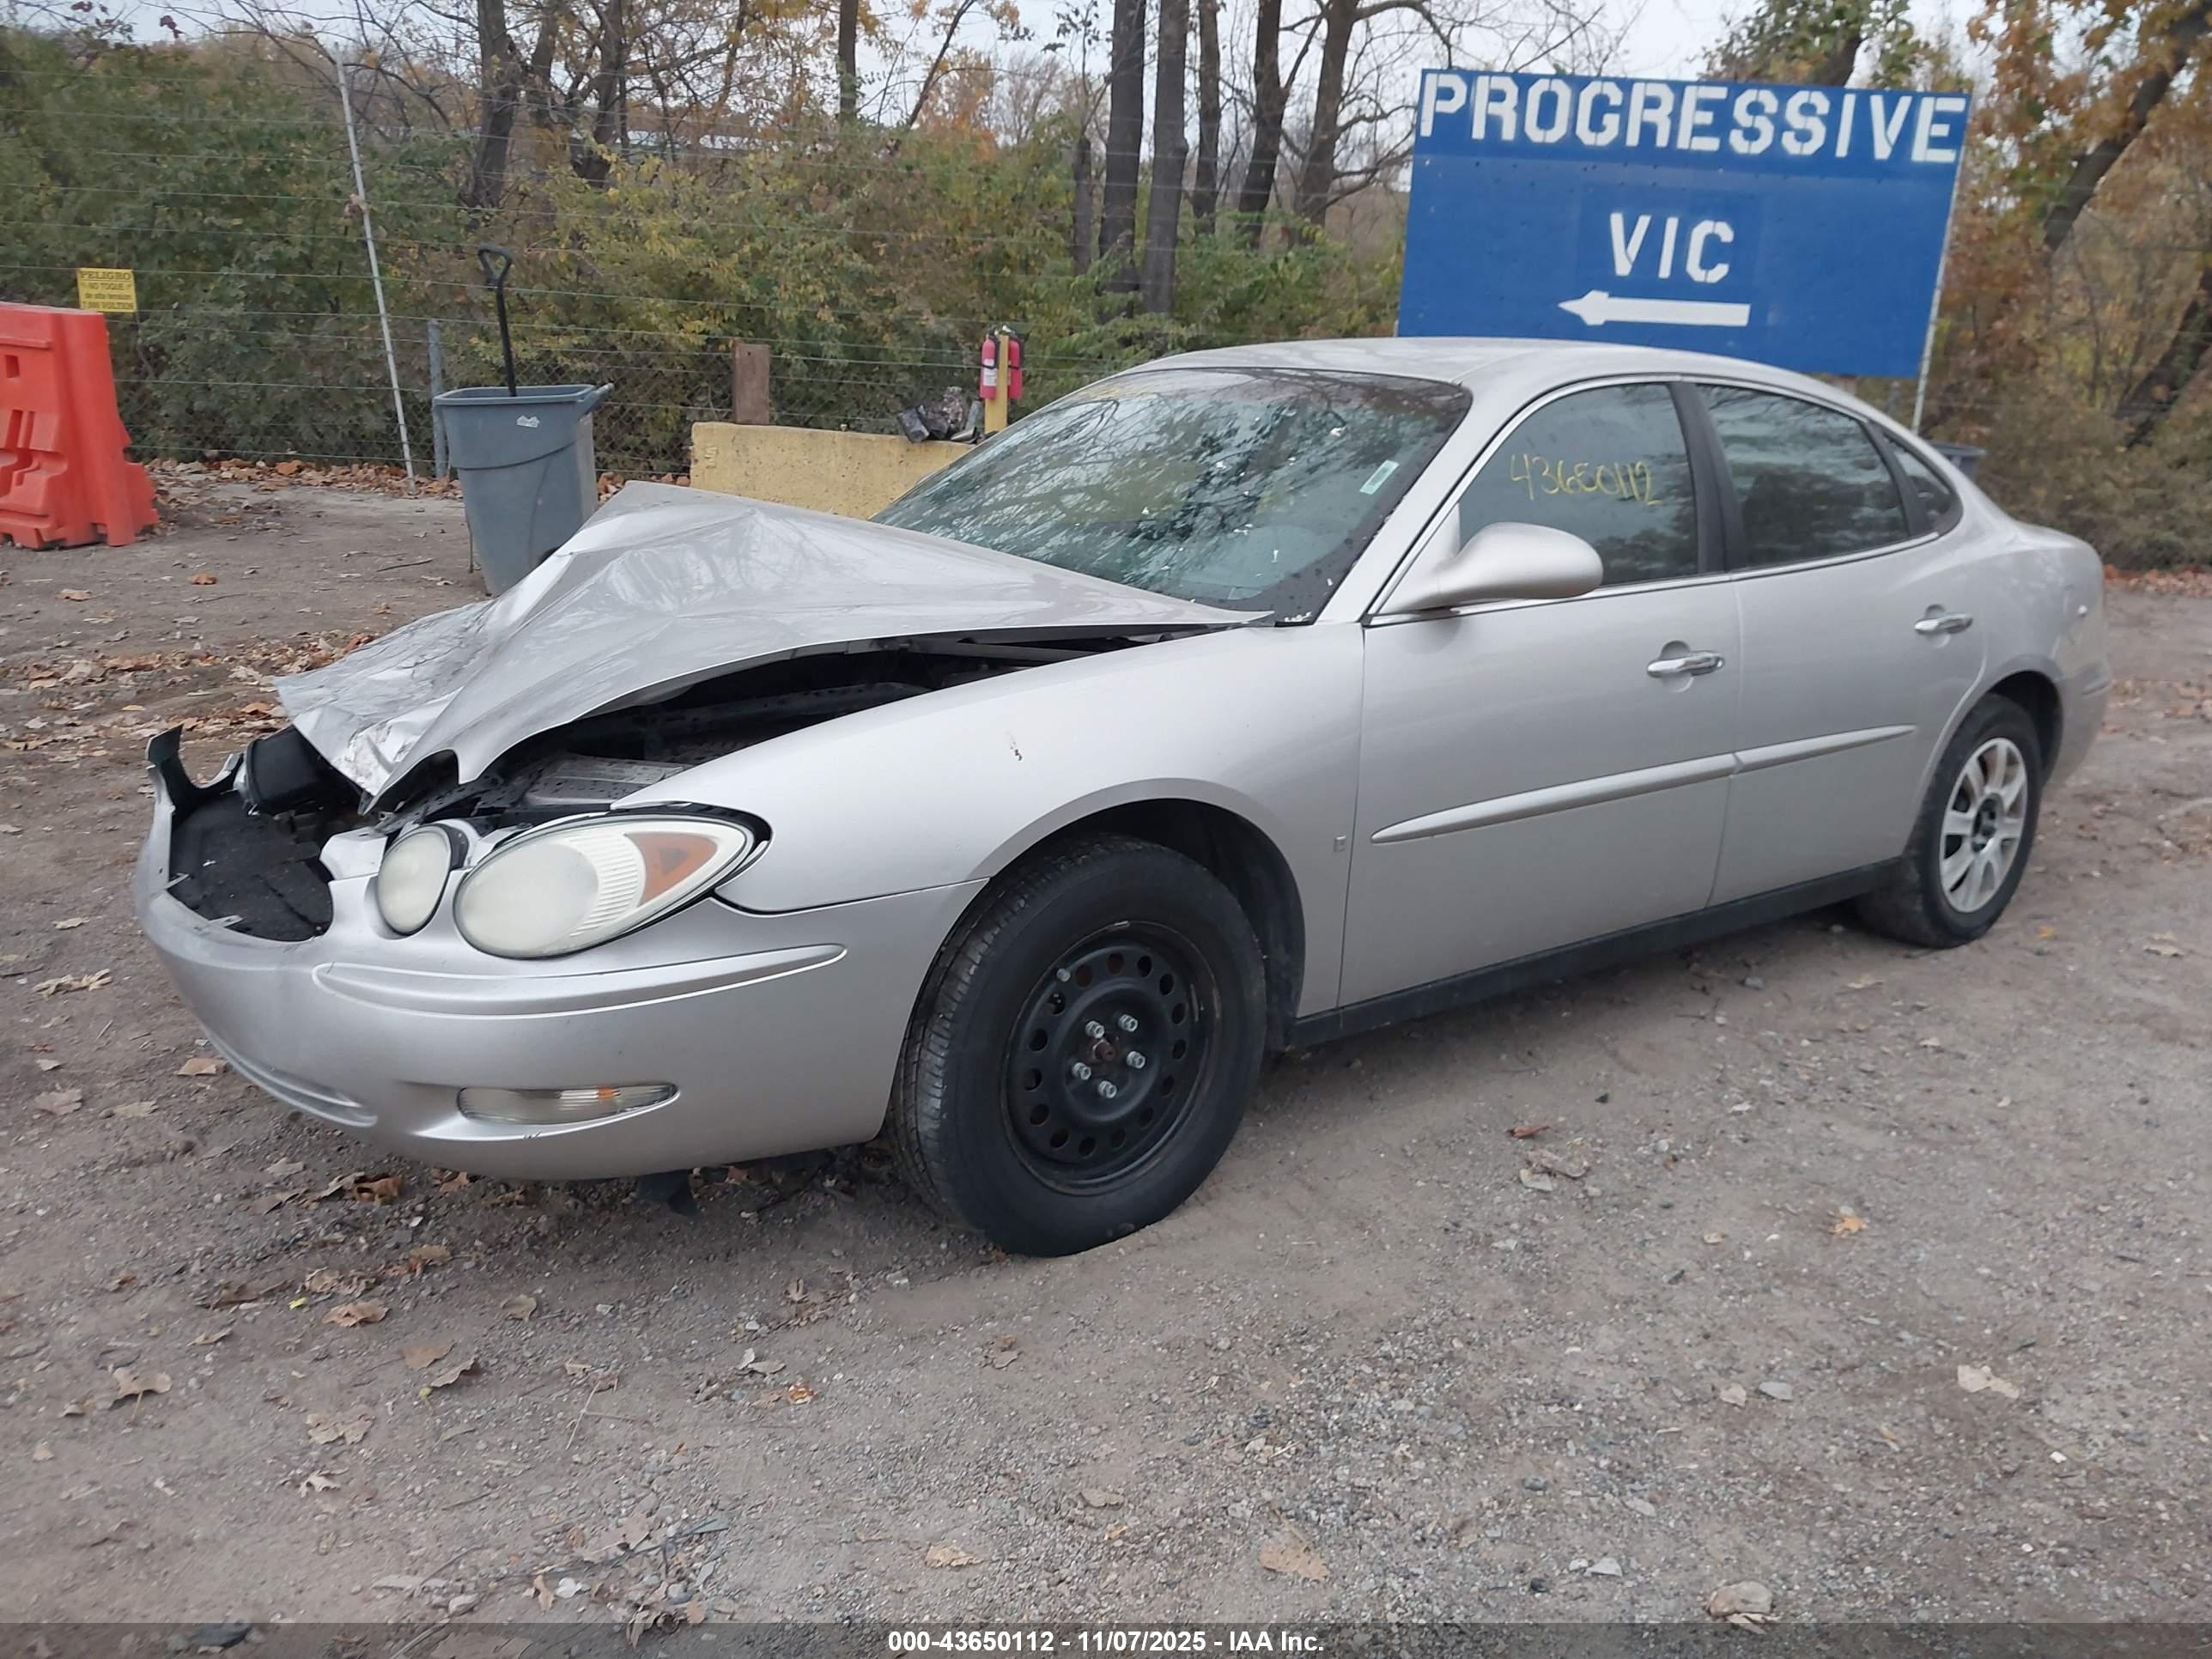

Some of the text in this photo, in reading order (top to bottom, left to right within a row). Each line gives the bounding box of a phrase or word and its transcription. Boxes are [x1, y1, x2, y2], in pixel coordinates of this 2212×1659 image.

[1419, 71, 1966, 164] PROGRESSIVE
[81, 270, 132, 282] PELIGRO
[1608, 211, 1735, 284] VIC
[1510, 453, 1663, 507] 43650112
